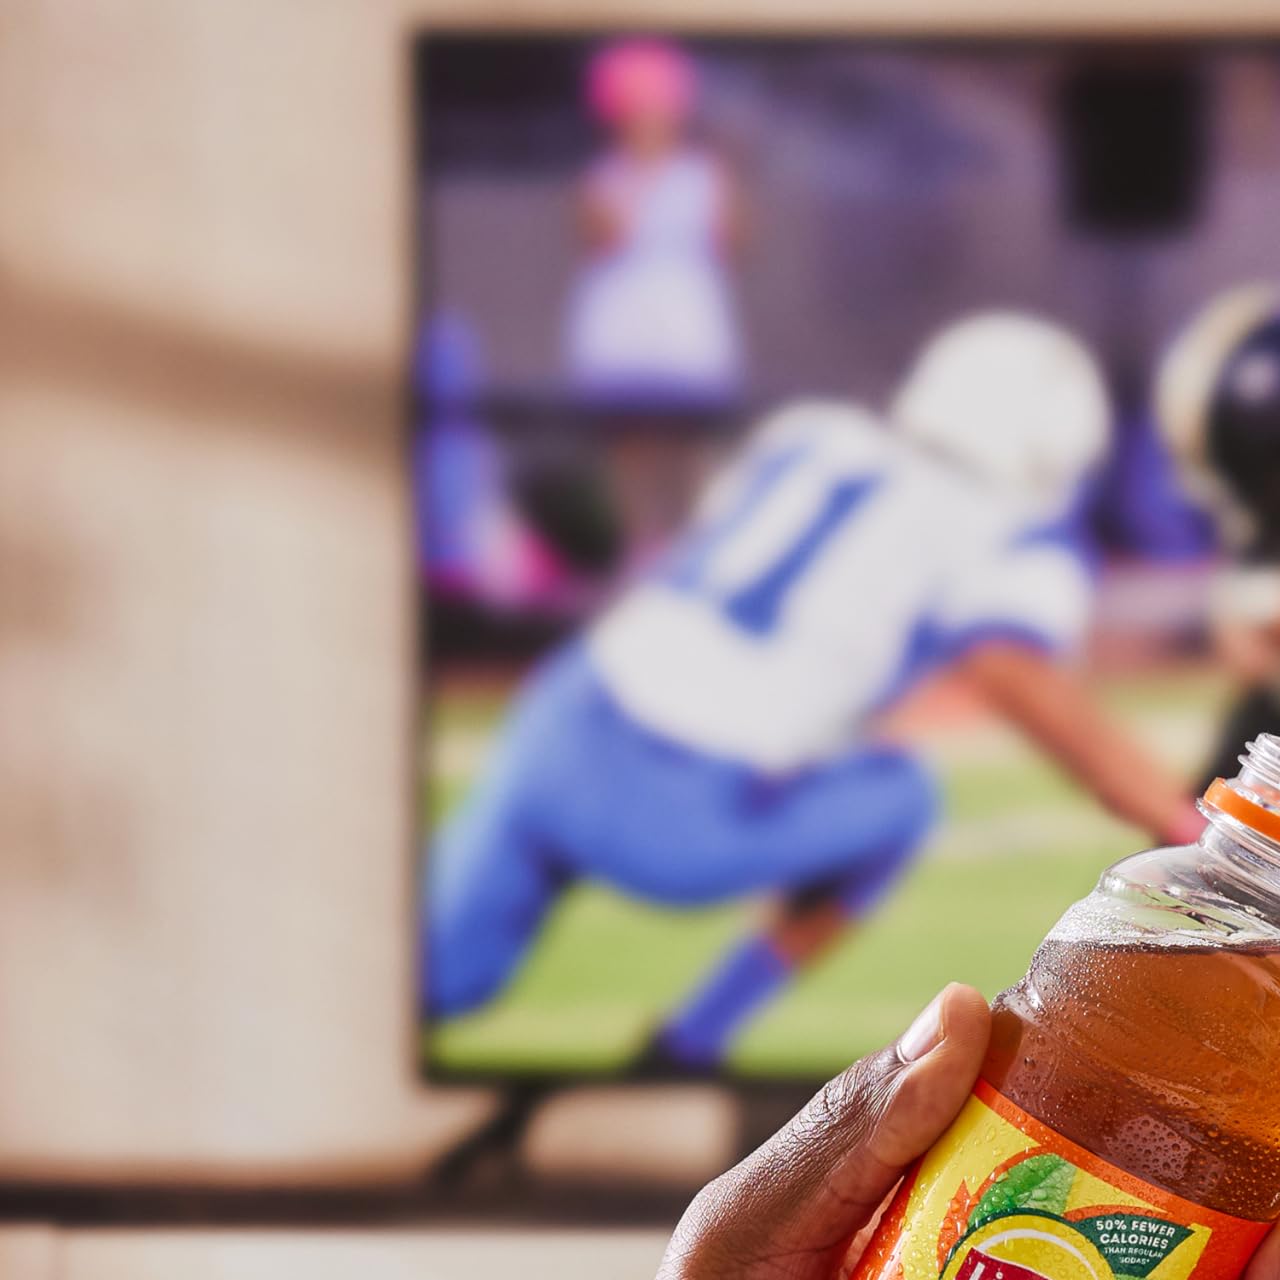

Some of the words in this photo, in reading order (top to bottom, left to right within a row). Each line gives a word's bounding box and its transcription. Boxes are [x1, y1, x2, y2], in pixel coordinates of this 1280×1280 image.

[1096, 1219, 1127, 1231] 50%
[1131, 1220, 1176, 1237] FEWER
[1099, 1233, 1169, 1249] CALORIES
[1128, 1247, 1164, 1258] REGULAR
